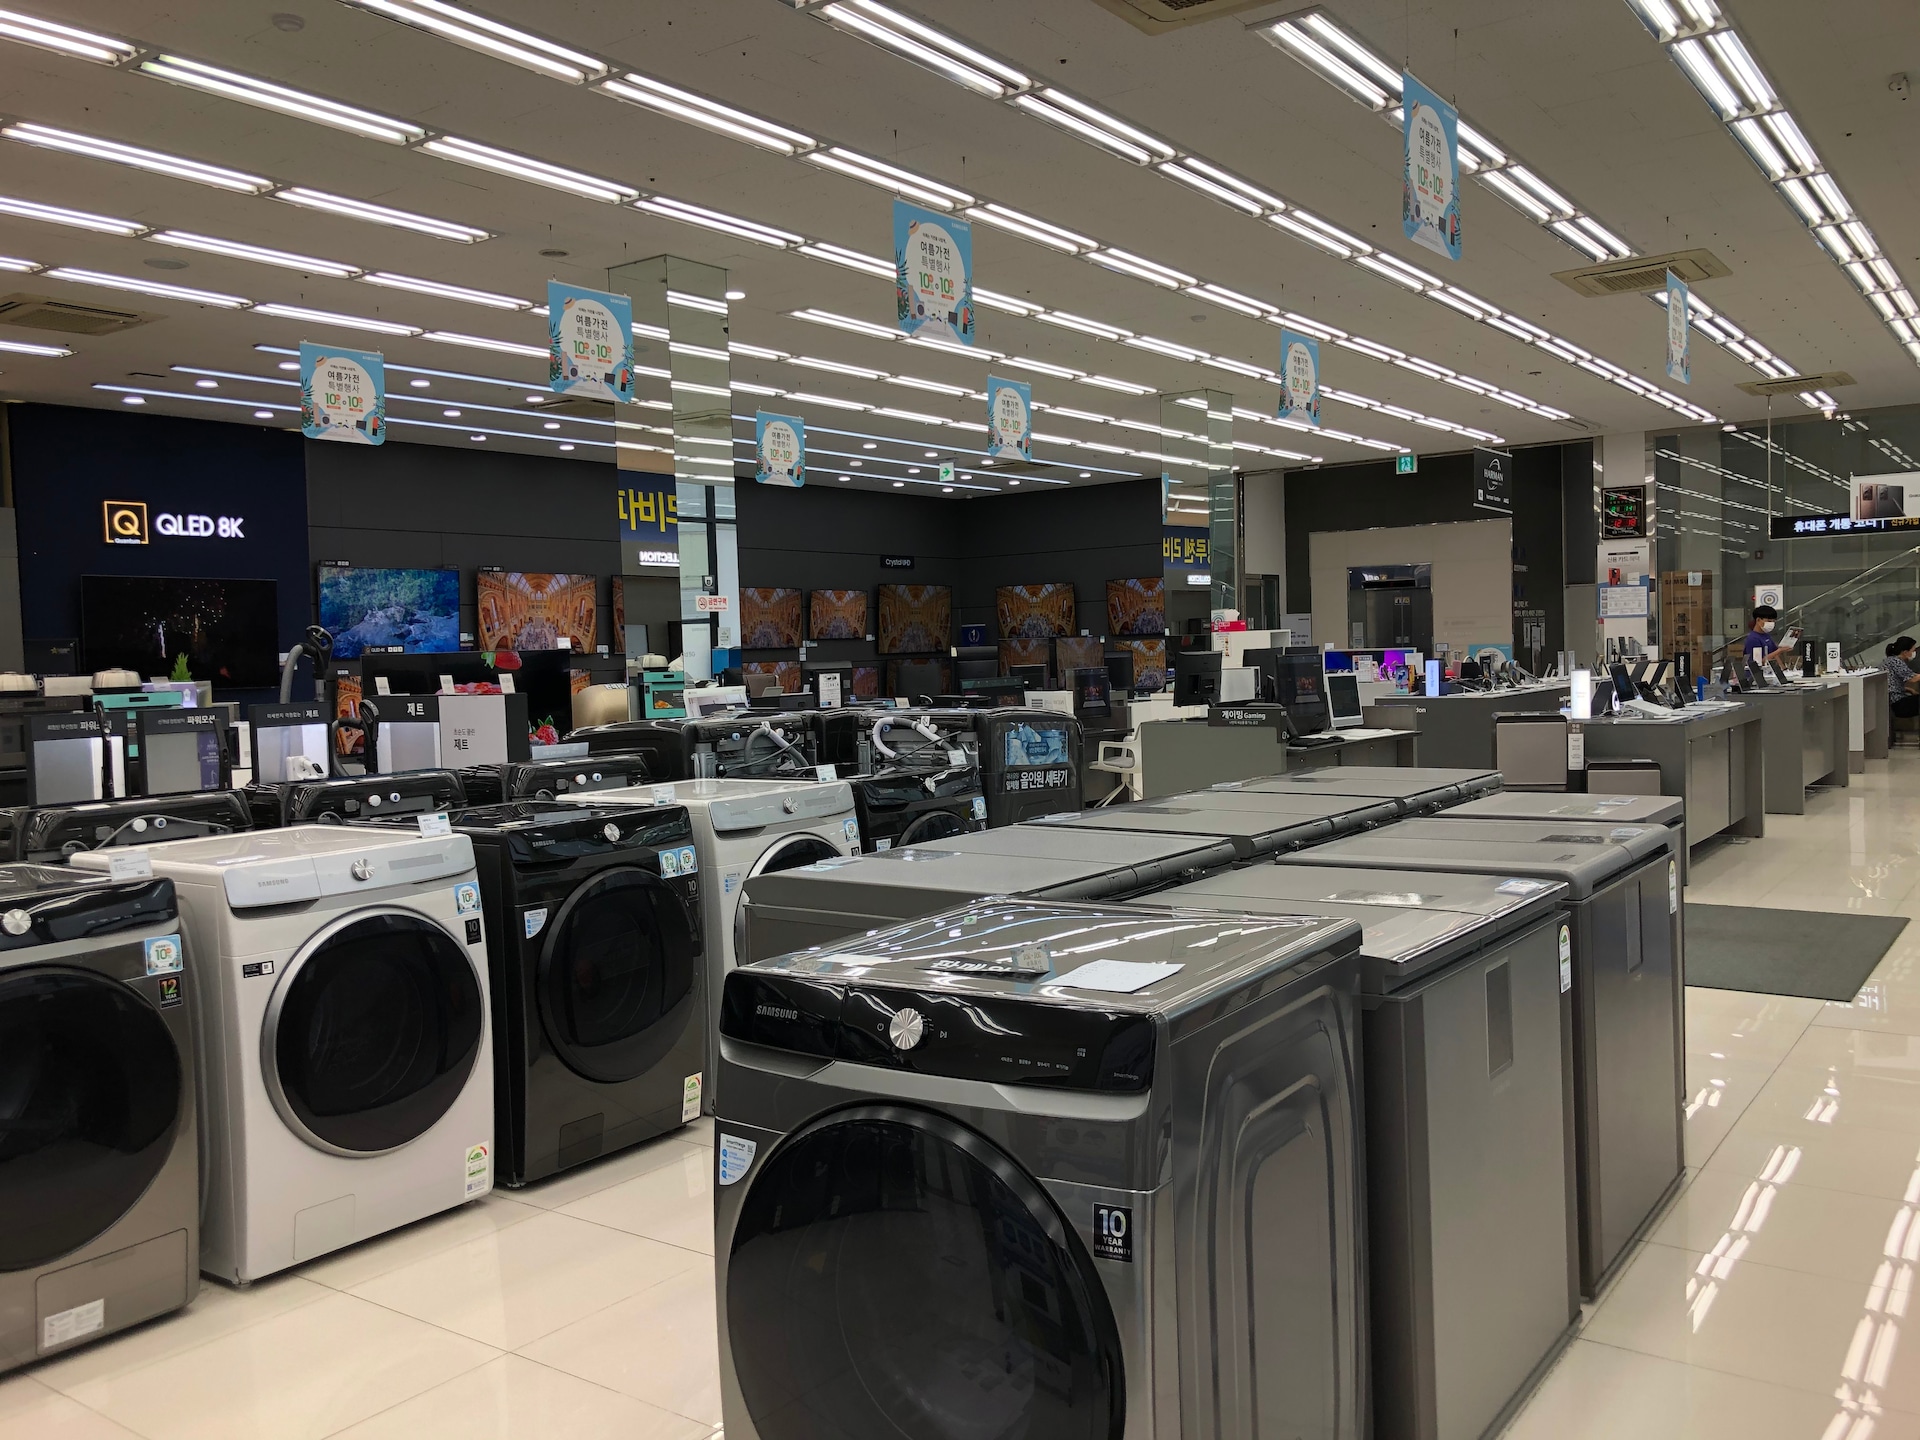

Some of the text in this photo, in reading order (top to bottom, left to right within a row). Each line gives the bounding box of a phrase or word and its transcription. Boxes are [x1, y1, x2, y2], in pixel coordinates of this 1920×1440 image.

[1419, 127, 1442, 154] 여름가전
[1420, 145, 1442, 172] 특별행사
[921, 242, 950, 260] 여름가전
[922, 256, 950, 274] 특별행사
[576, 314, 608, 330] 여름가전
[576, 327, 608, 342] 특별행사
[328, 370, 360, 384] 여름가전
[328, 382, 360, 394] 특별행사
[113, 510, 142, 536] Q
[156, 513, 245, 538] QLED 8K
[1794, 520, 1826, 532] 휴대폰
[1829, 518, 1850, 530] 개통
[306, 710, 319, 718] 제트
[407, 702, 424, 716] 제트
[1222, 710, 1266, 720] 게이밍 Gaming
[80, 720, 112, 730] 파워
[454, 738, 469, 750] 제트
[1020, 770, 1068, 790] 올인원 세탁기
[532, 840, 556, 848] SAMSUNG
[258, 878, 289, 888] SAMSUNG
[688, 880, 696, 892] 10
[468, 921, 478, 932] 10
[161, 979, 178, 994] 12
[756, 1004, 798, 1020] SAMSUNG
[1098, 1208, 1126, 1238] 10
[1102, 1236, 1122, 1246] YEAR
[1094, 1244, 1131, 1256] WARRANTY
